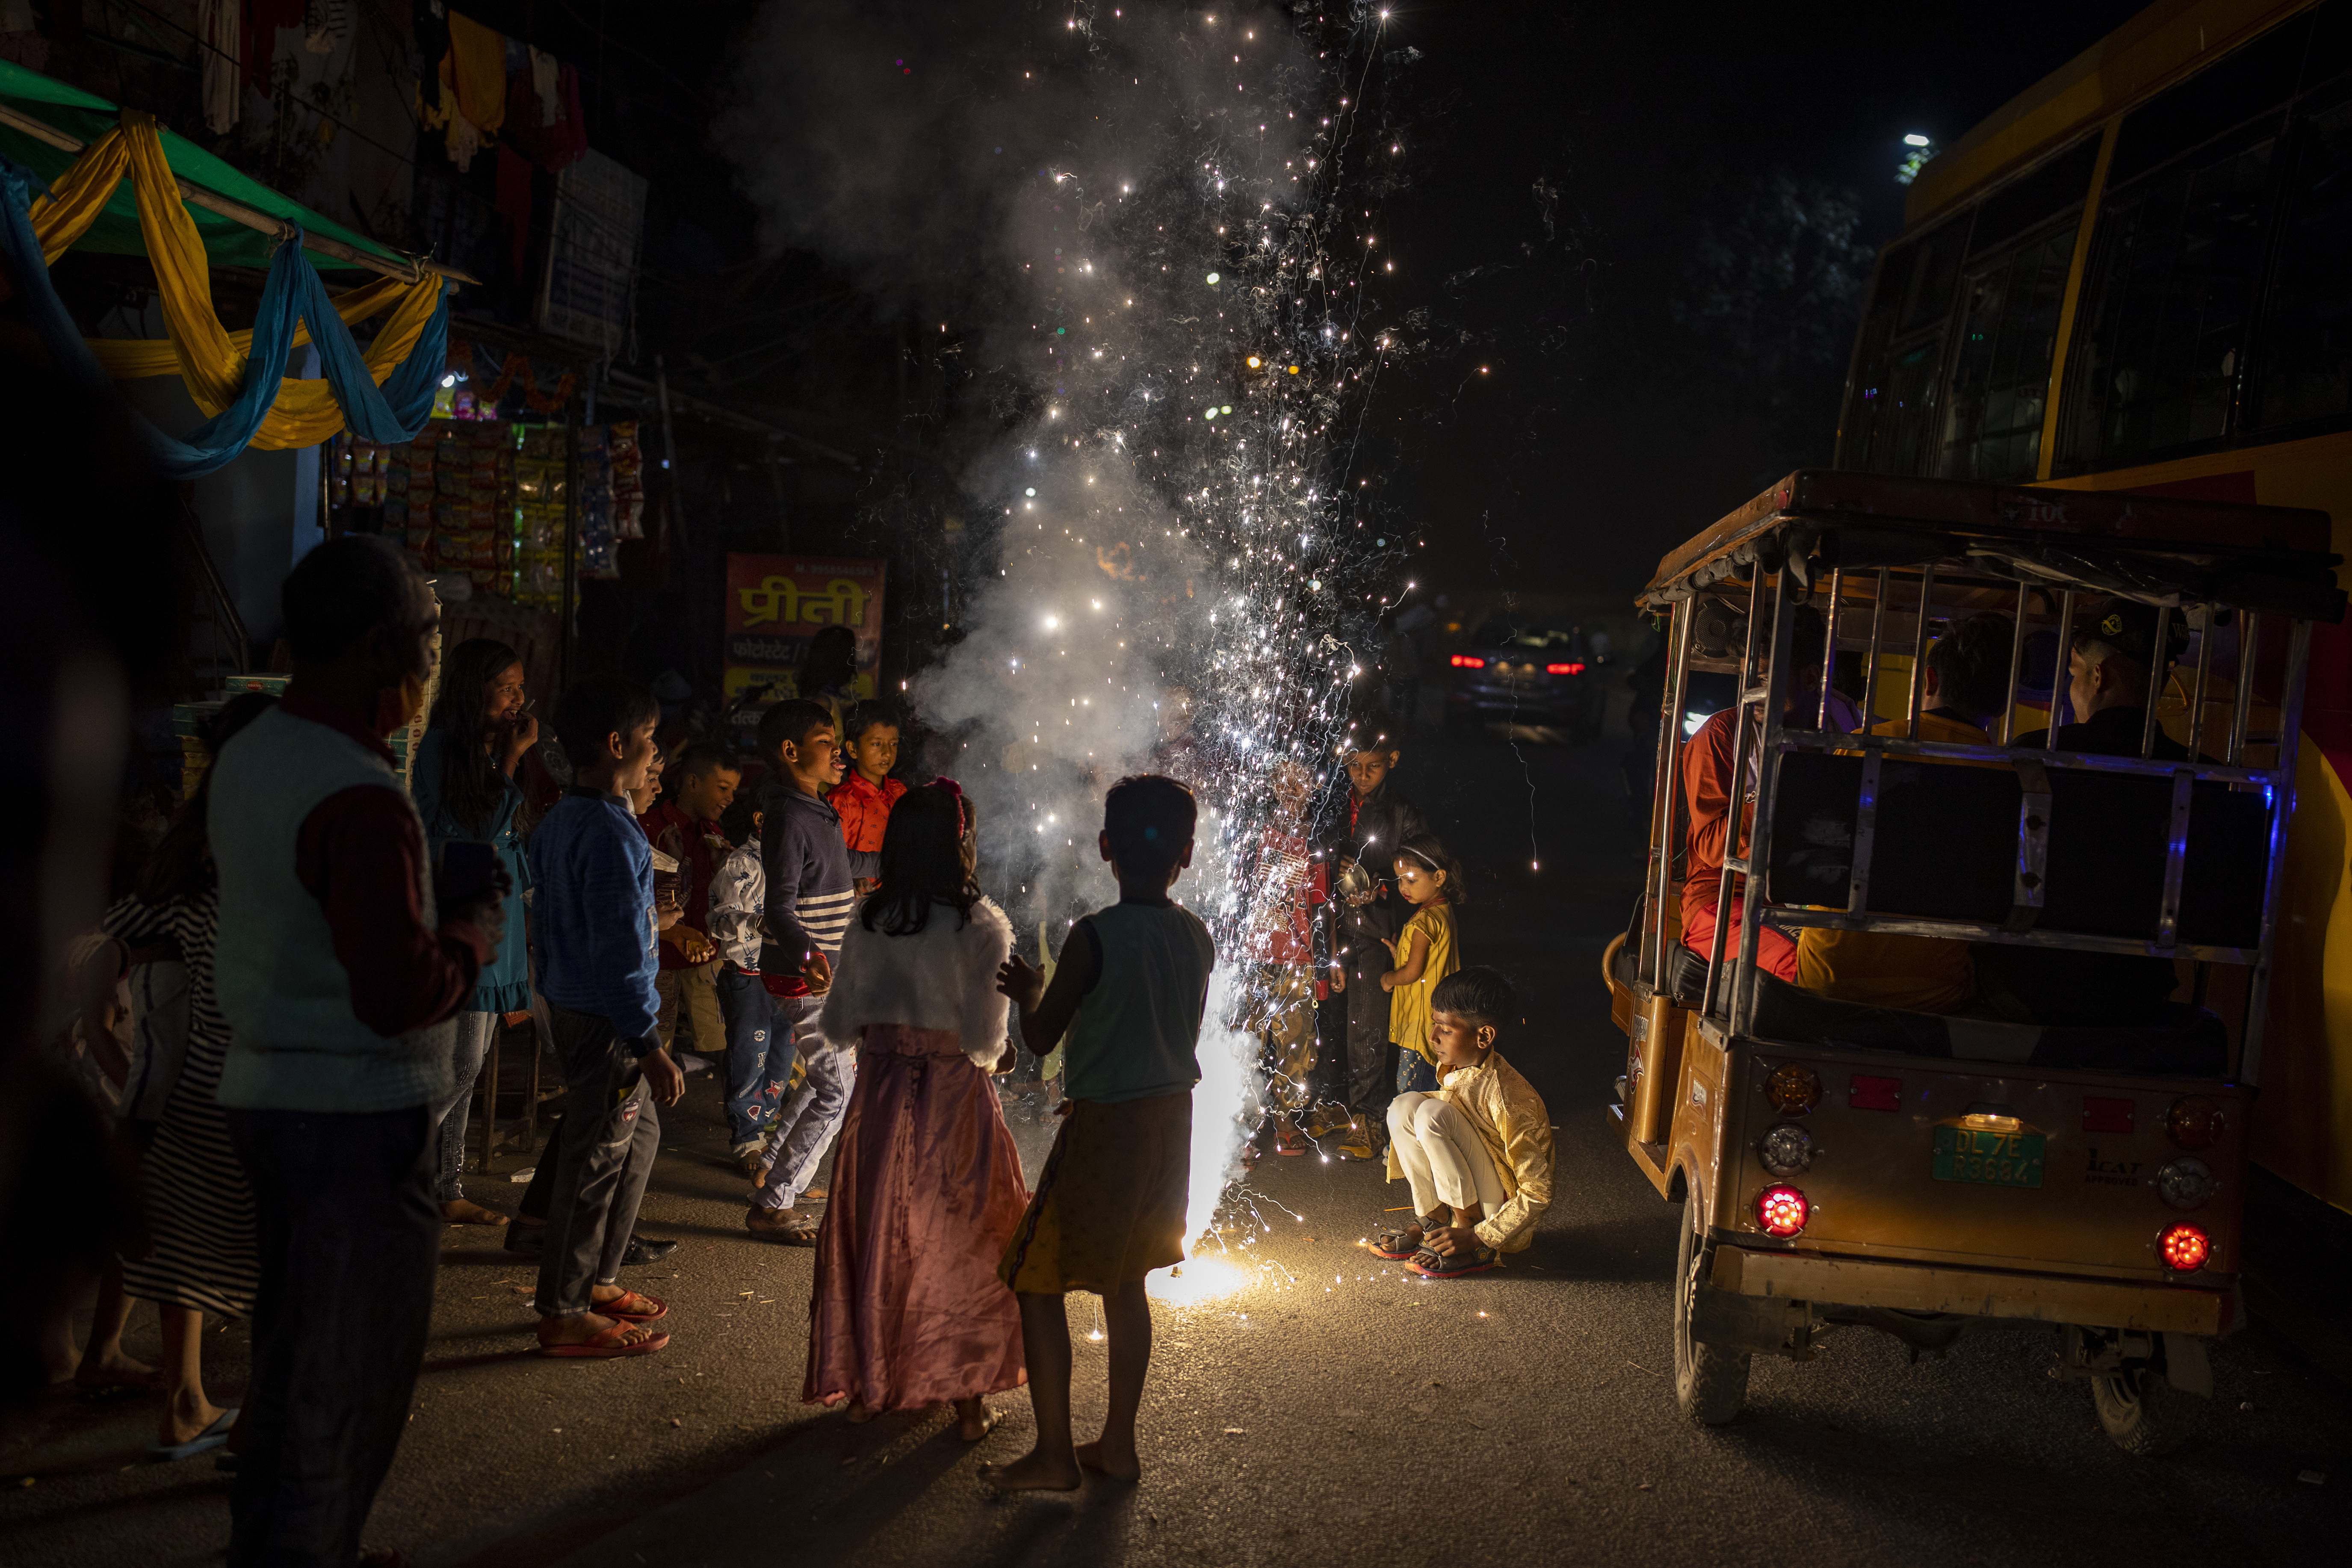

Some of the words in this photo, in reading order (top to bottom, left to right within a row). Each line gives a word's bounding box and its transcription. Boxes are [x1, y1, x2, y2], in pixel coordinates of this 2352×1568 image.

[737, 574, 871, 628] प्रीती
[1955, 1130, 1984, 1155] DL
[1992, 1133, 2022, 1158] 7E
[1953, 1155, 2029, 1184] R3684
[2085, 1175, 2138, 1186] APPROVED
